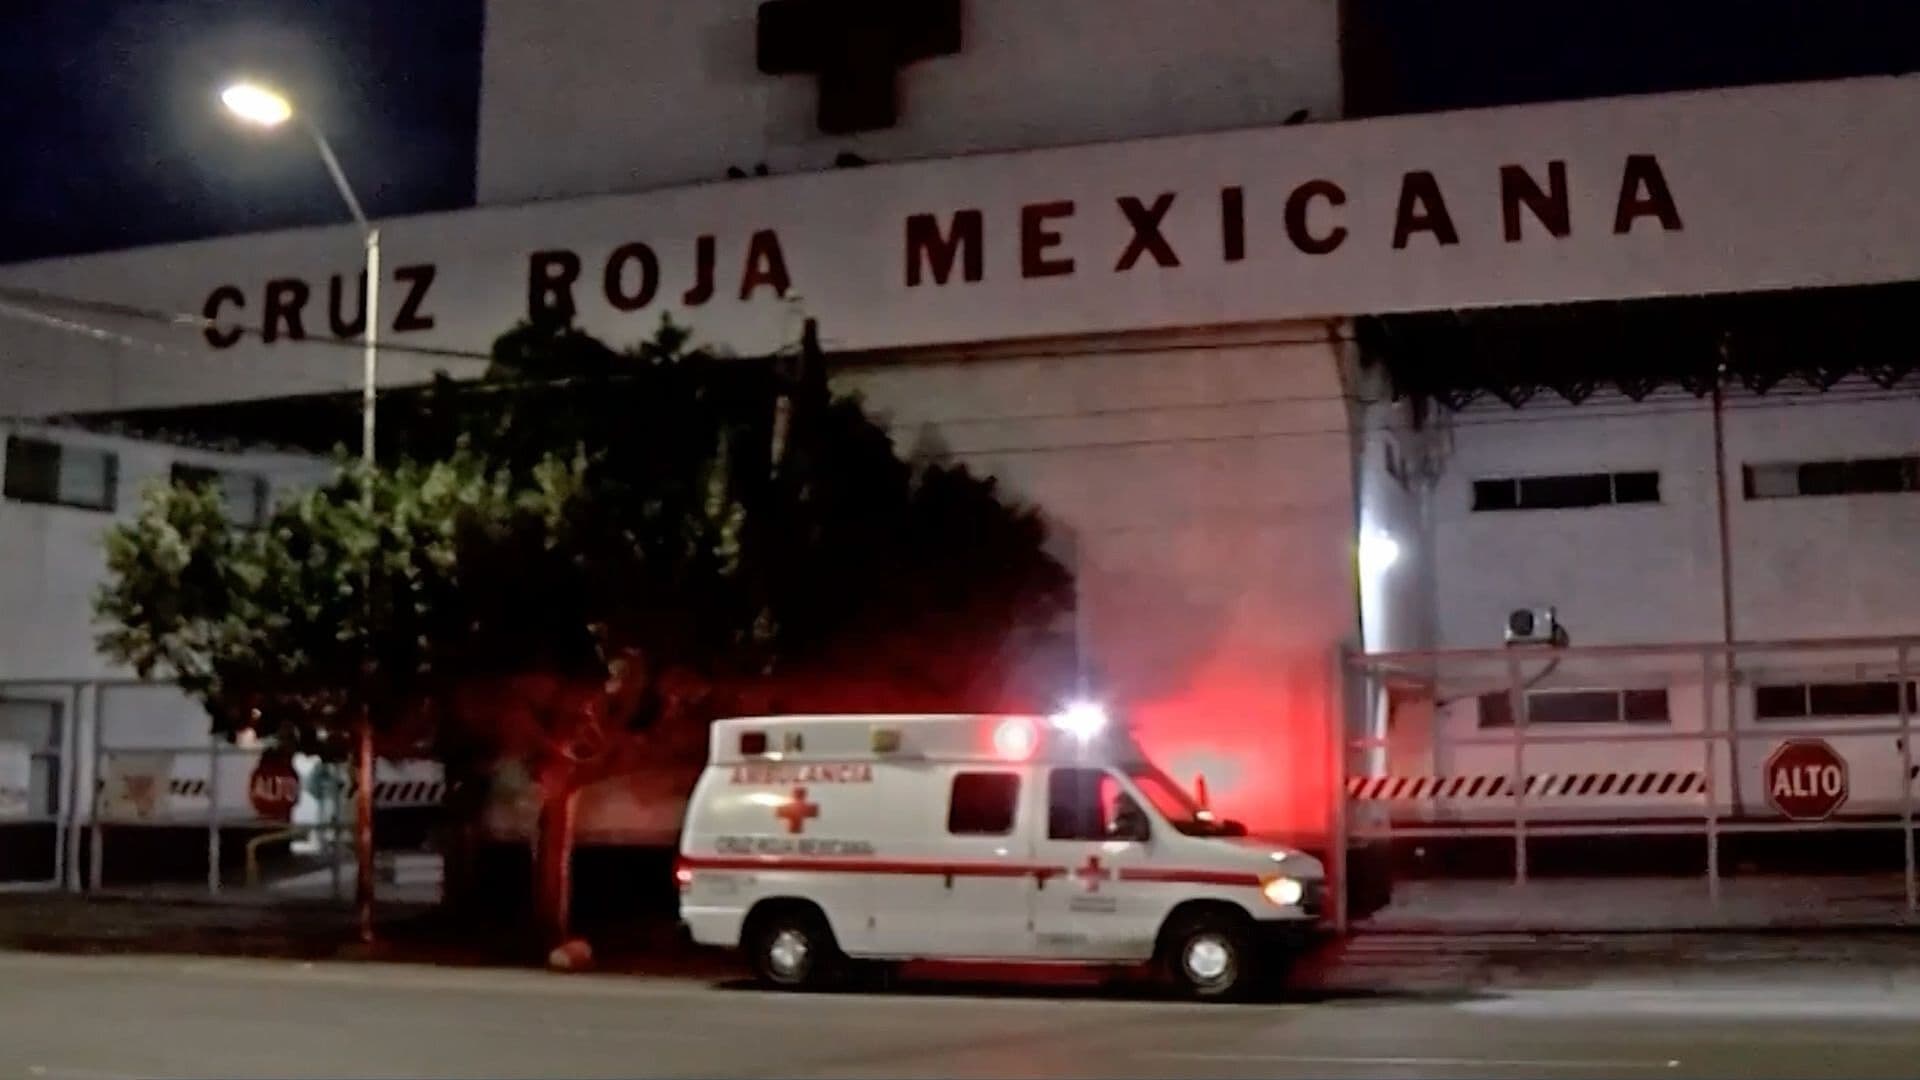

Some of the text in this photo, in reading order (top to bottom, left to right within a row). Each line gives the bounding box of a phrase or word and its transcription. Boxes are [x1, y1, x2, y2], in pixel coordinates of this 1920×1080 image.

[203, 155, 1684, 348] CRUZ ROJA MEXICANA
[730, 763, 874, 785] AMBULANCIA
[1773, 764, 1841, 797] ALTO
